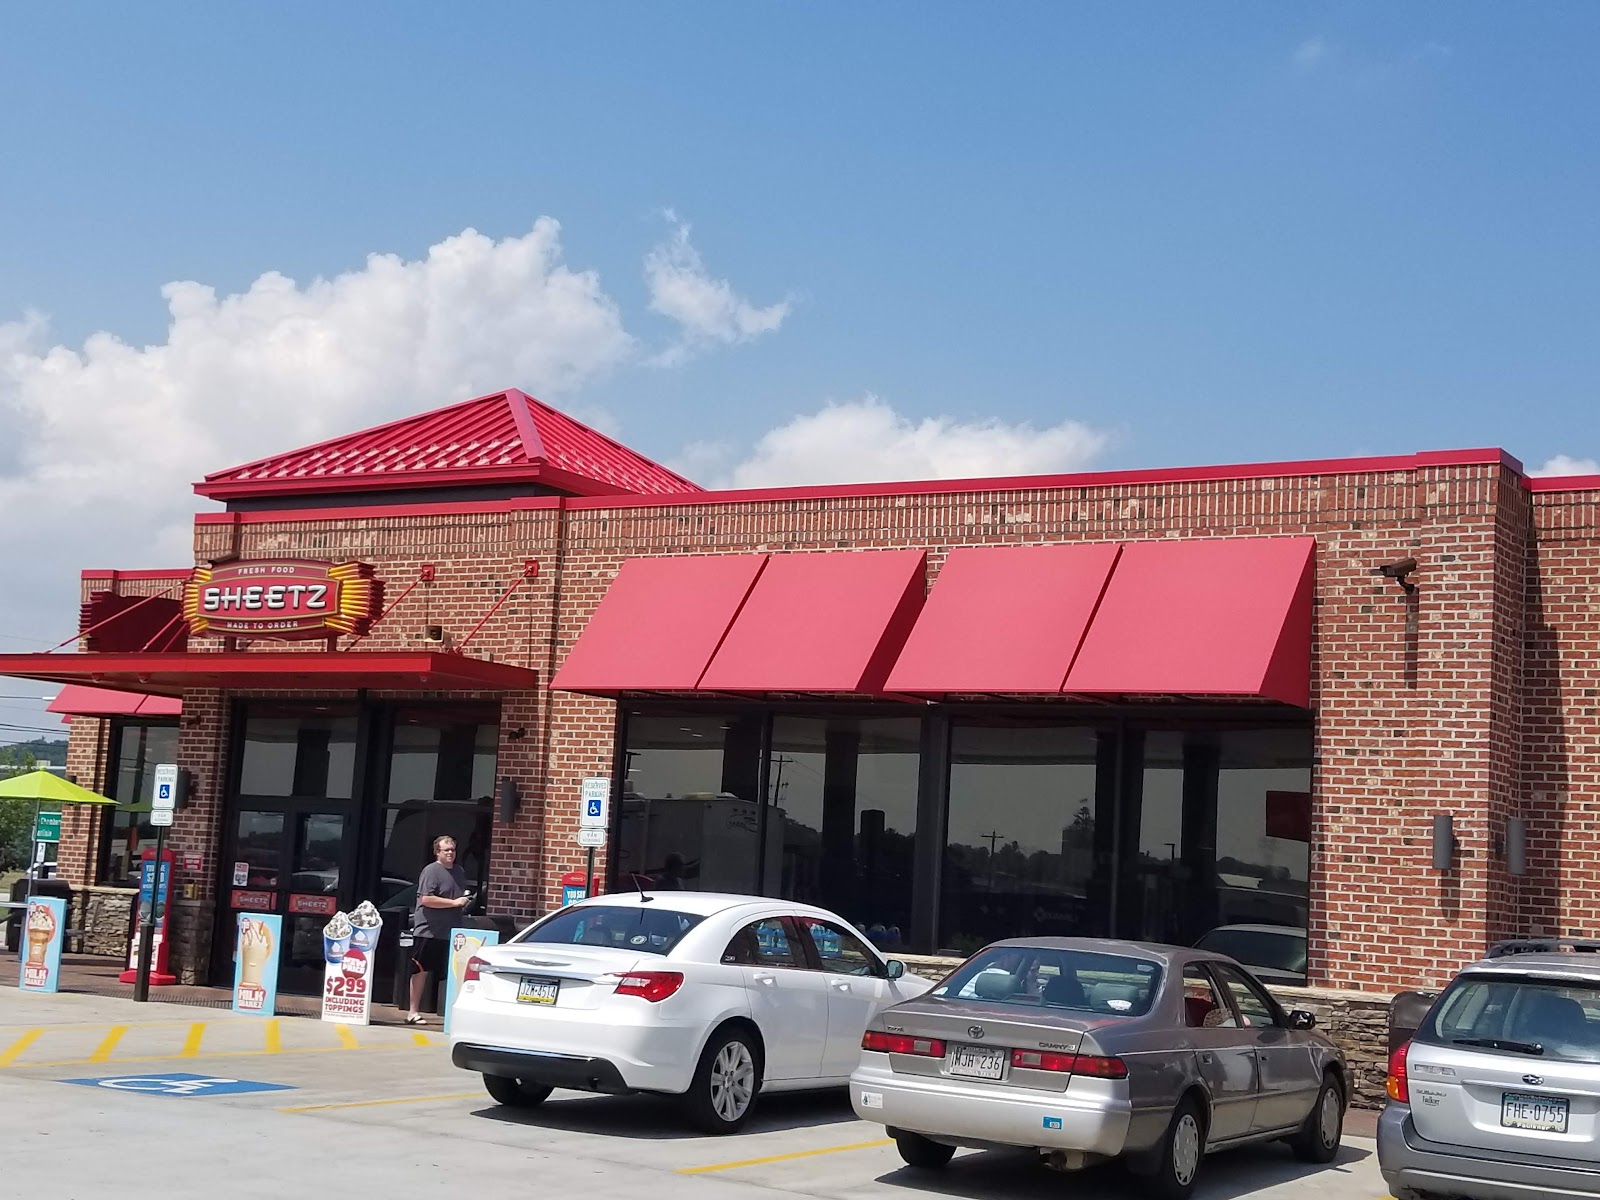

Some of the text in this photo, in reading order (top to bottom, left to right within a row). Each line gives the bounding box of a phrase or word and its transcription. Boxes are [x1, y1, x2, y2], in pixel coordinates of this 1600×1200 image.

[238, 566, 295, 575] FRESH FOOD
[203, 584, 327, 611] SHEETZ
[253, 622, 264, 630] TO
[267, 620, 299, 629] ORDER
[585, 790, 606, 799] PARKING
[239, 895, 269, 905] SHEETZ
[297, 899, 328, 908] SHEETZ
[24, 968, 47, 980] MILK
[238, 988, 265, 1002] MILK
[325, 996, 366, 1006] INCLUDING
[325, 1003, 364, 1014] TOPPINGS
[980, 1055, 1001, 1070] 236
